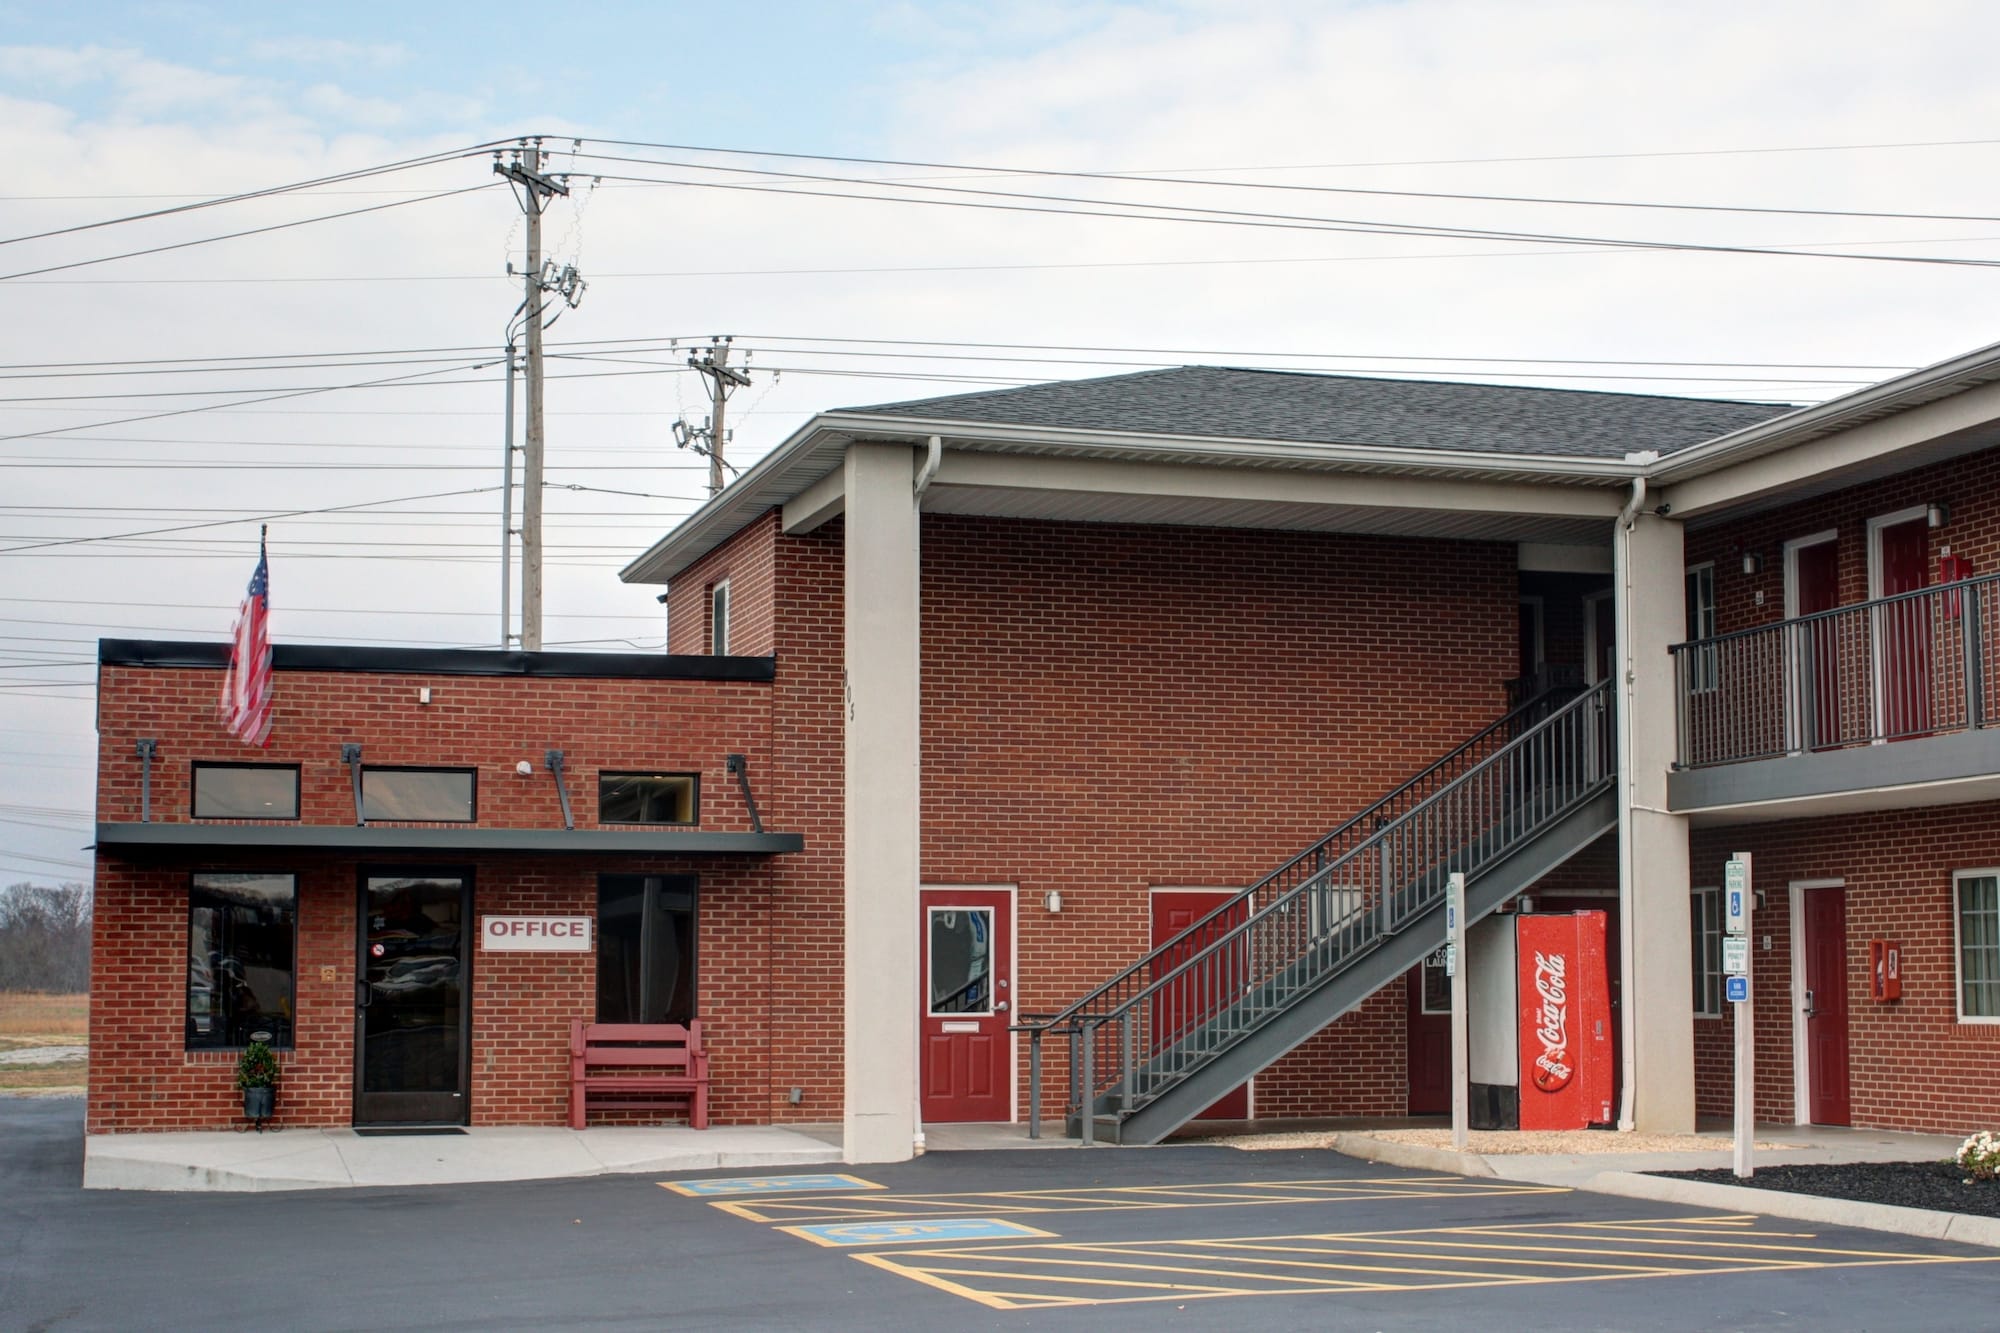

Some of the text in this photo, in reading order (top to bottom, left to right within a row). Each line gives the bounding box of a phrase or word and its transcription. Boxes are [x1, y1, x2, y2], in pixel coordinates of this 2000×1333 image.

[489, 921, 584, 937] OFFICE
[1435, 949, 1447, 958] CO
[1535, 950, 1566, 1049] Coca-Cola
